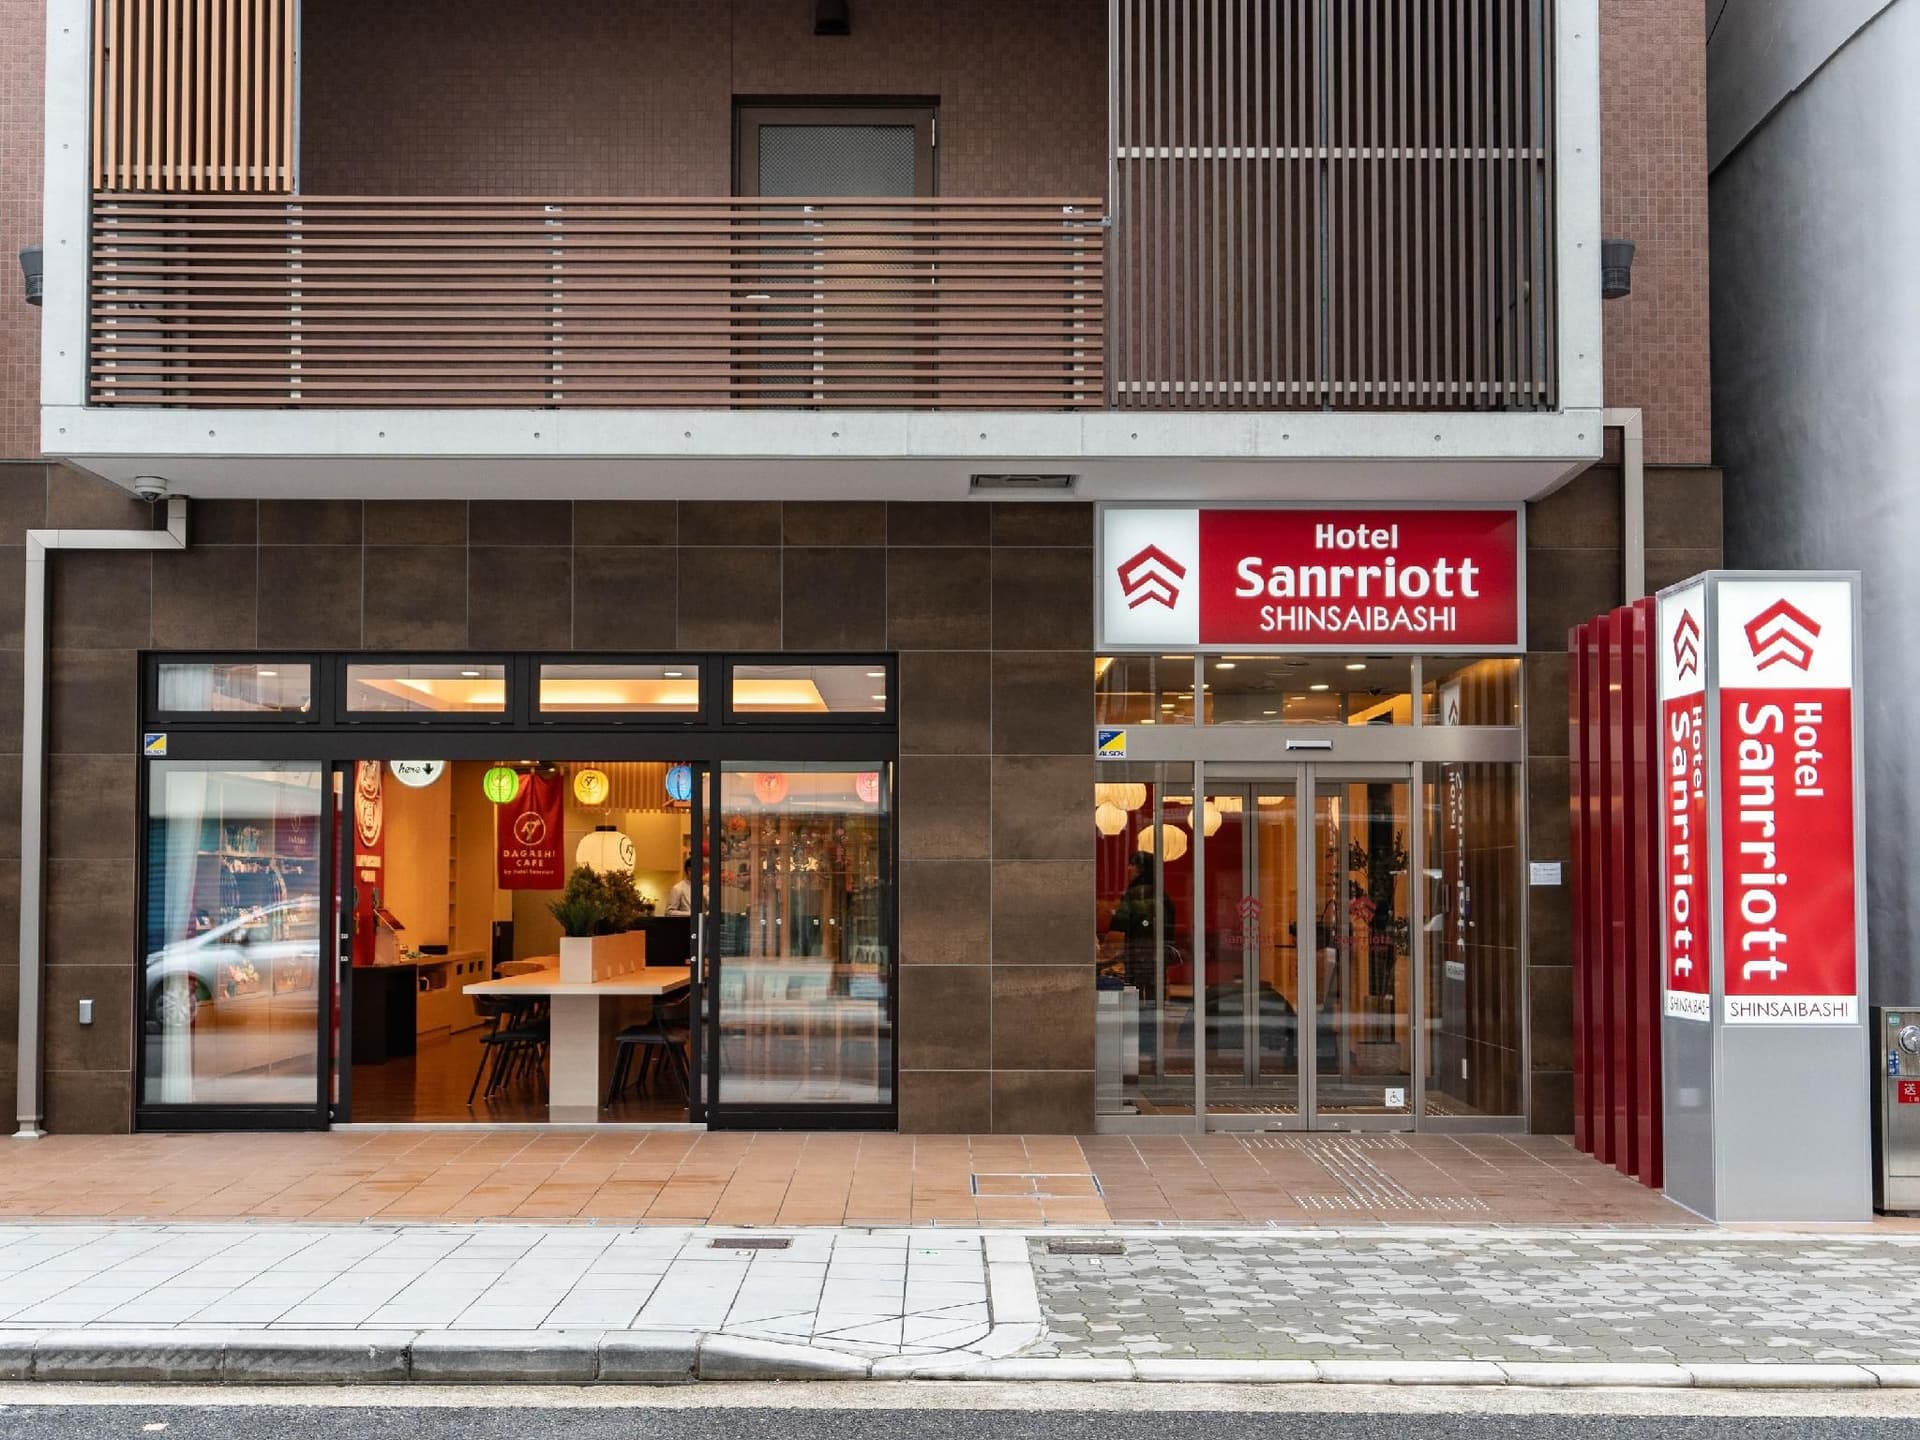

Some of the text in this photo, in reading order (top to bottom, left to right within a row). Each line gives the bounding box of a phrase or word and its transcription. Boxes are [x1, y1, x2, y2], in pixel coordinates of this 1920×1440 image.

[1315, 523, 1399, 549] Hotel
[1235, 556, 1480, 598] Sanrriott
[1259, 605, 1457, 632] SHINSAIBASHI
[1690, 705, 1704, 799] Hotel
[1793, 702, 1825, 798] Hotel
[1671, 710, 1694, 979] Sanrriott
[1737, 703, 1788, 981] Sanrriott
[516, 859, 544, 868] CAFE
[1730, 1002, 1849, 1017] SHINSAIBASHI
